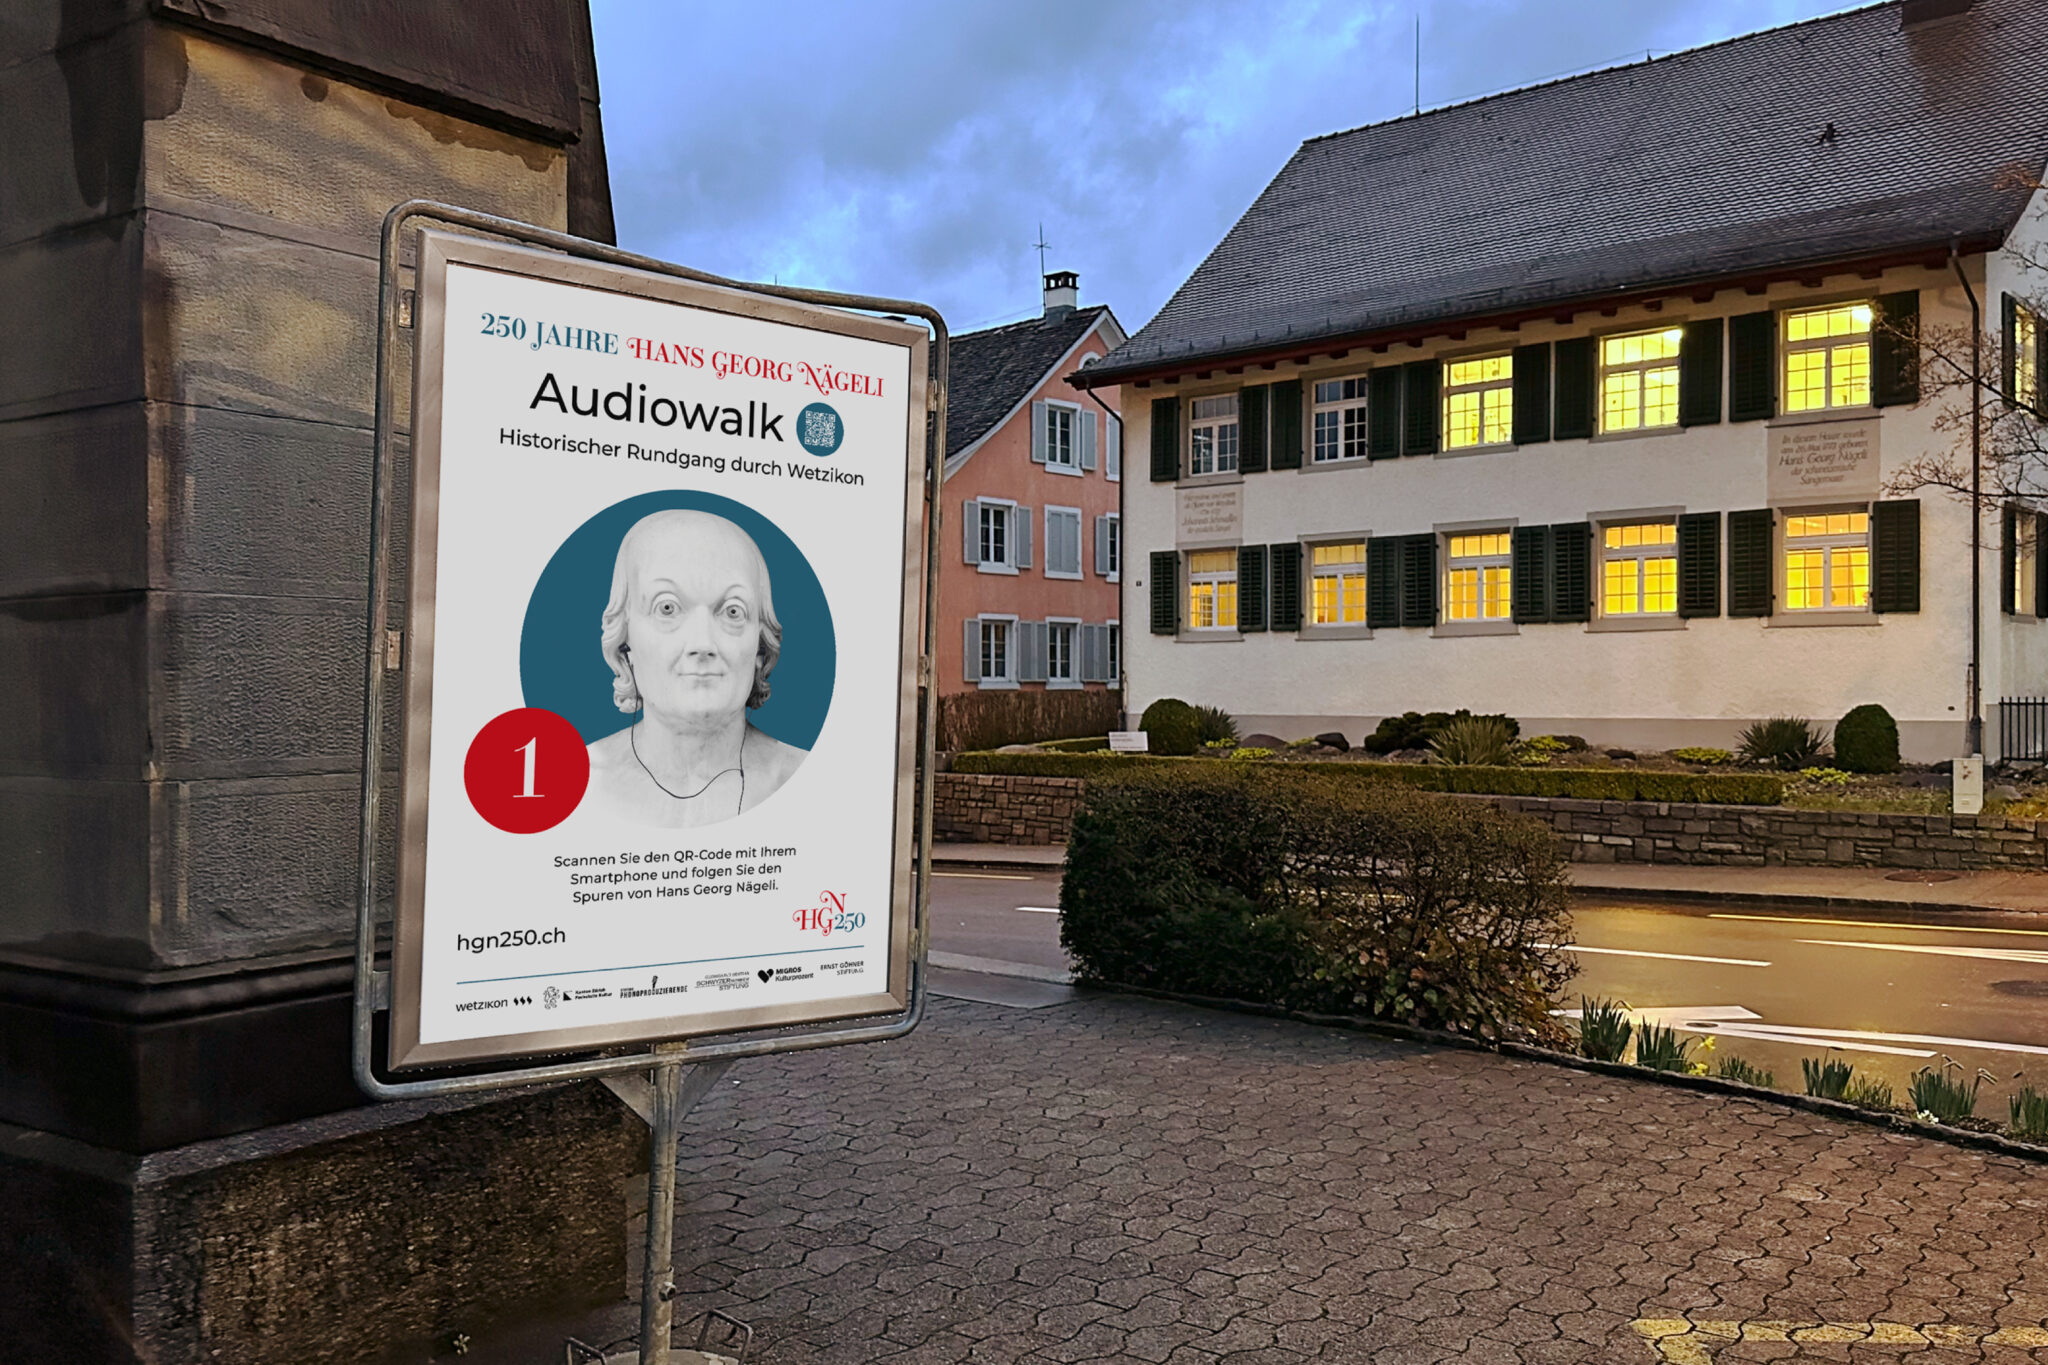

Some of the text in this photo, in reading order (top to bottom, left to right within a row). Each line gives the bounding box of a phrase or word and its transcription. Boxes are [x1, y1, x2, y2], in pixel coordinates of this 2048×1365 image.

[481, 312, 885, 397] 250 JAHRE HANS GEORG NÄGELI
[529, 372, 784, 442] Audiowalk
[499, 428, 865, 487] Historischer Rundgang durch Wetzikon
[512, 736, 545, 798] 1
[553, 844, 797, 868] Scannen Sie den QR-Code mit Ihrem
[570, 862, 782, 887] Smartphone und folgen Sie den
[572, 879, 779, 905] Spuren von Hans Georg Nägeli.
[457, 926, 566, 954] hgn250.ch
[775, 972, 814, 983] Kulturprozent
[776, 966, 802, 975] MIGROS
[719, 983, 750, 991] STIFTUNG
